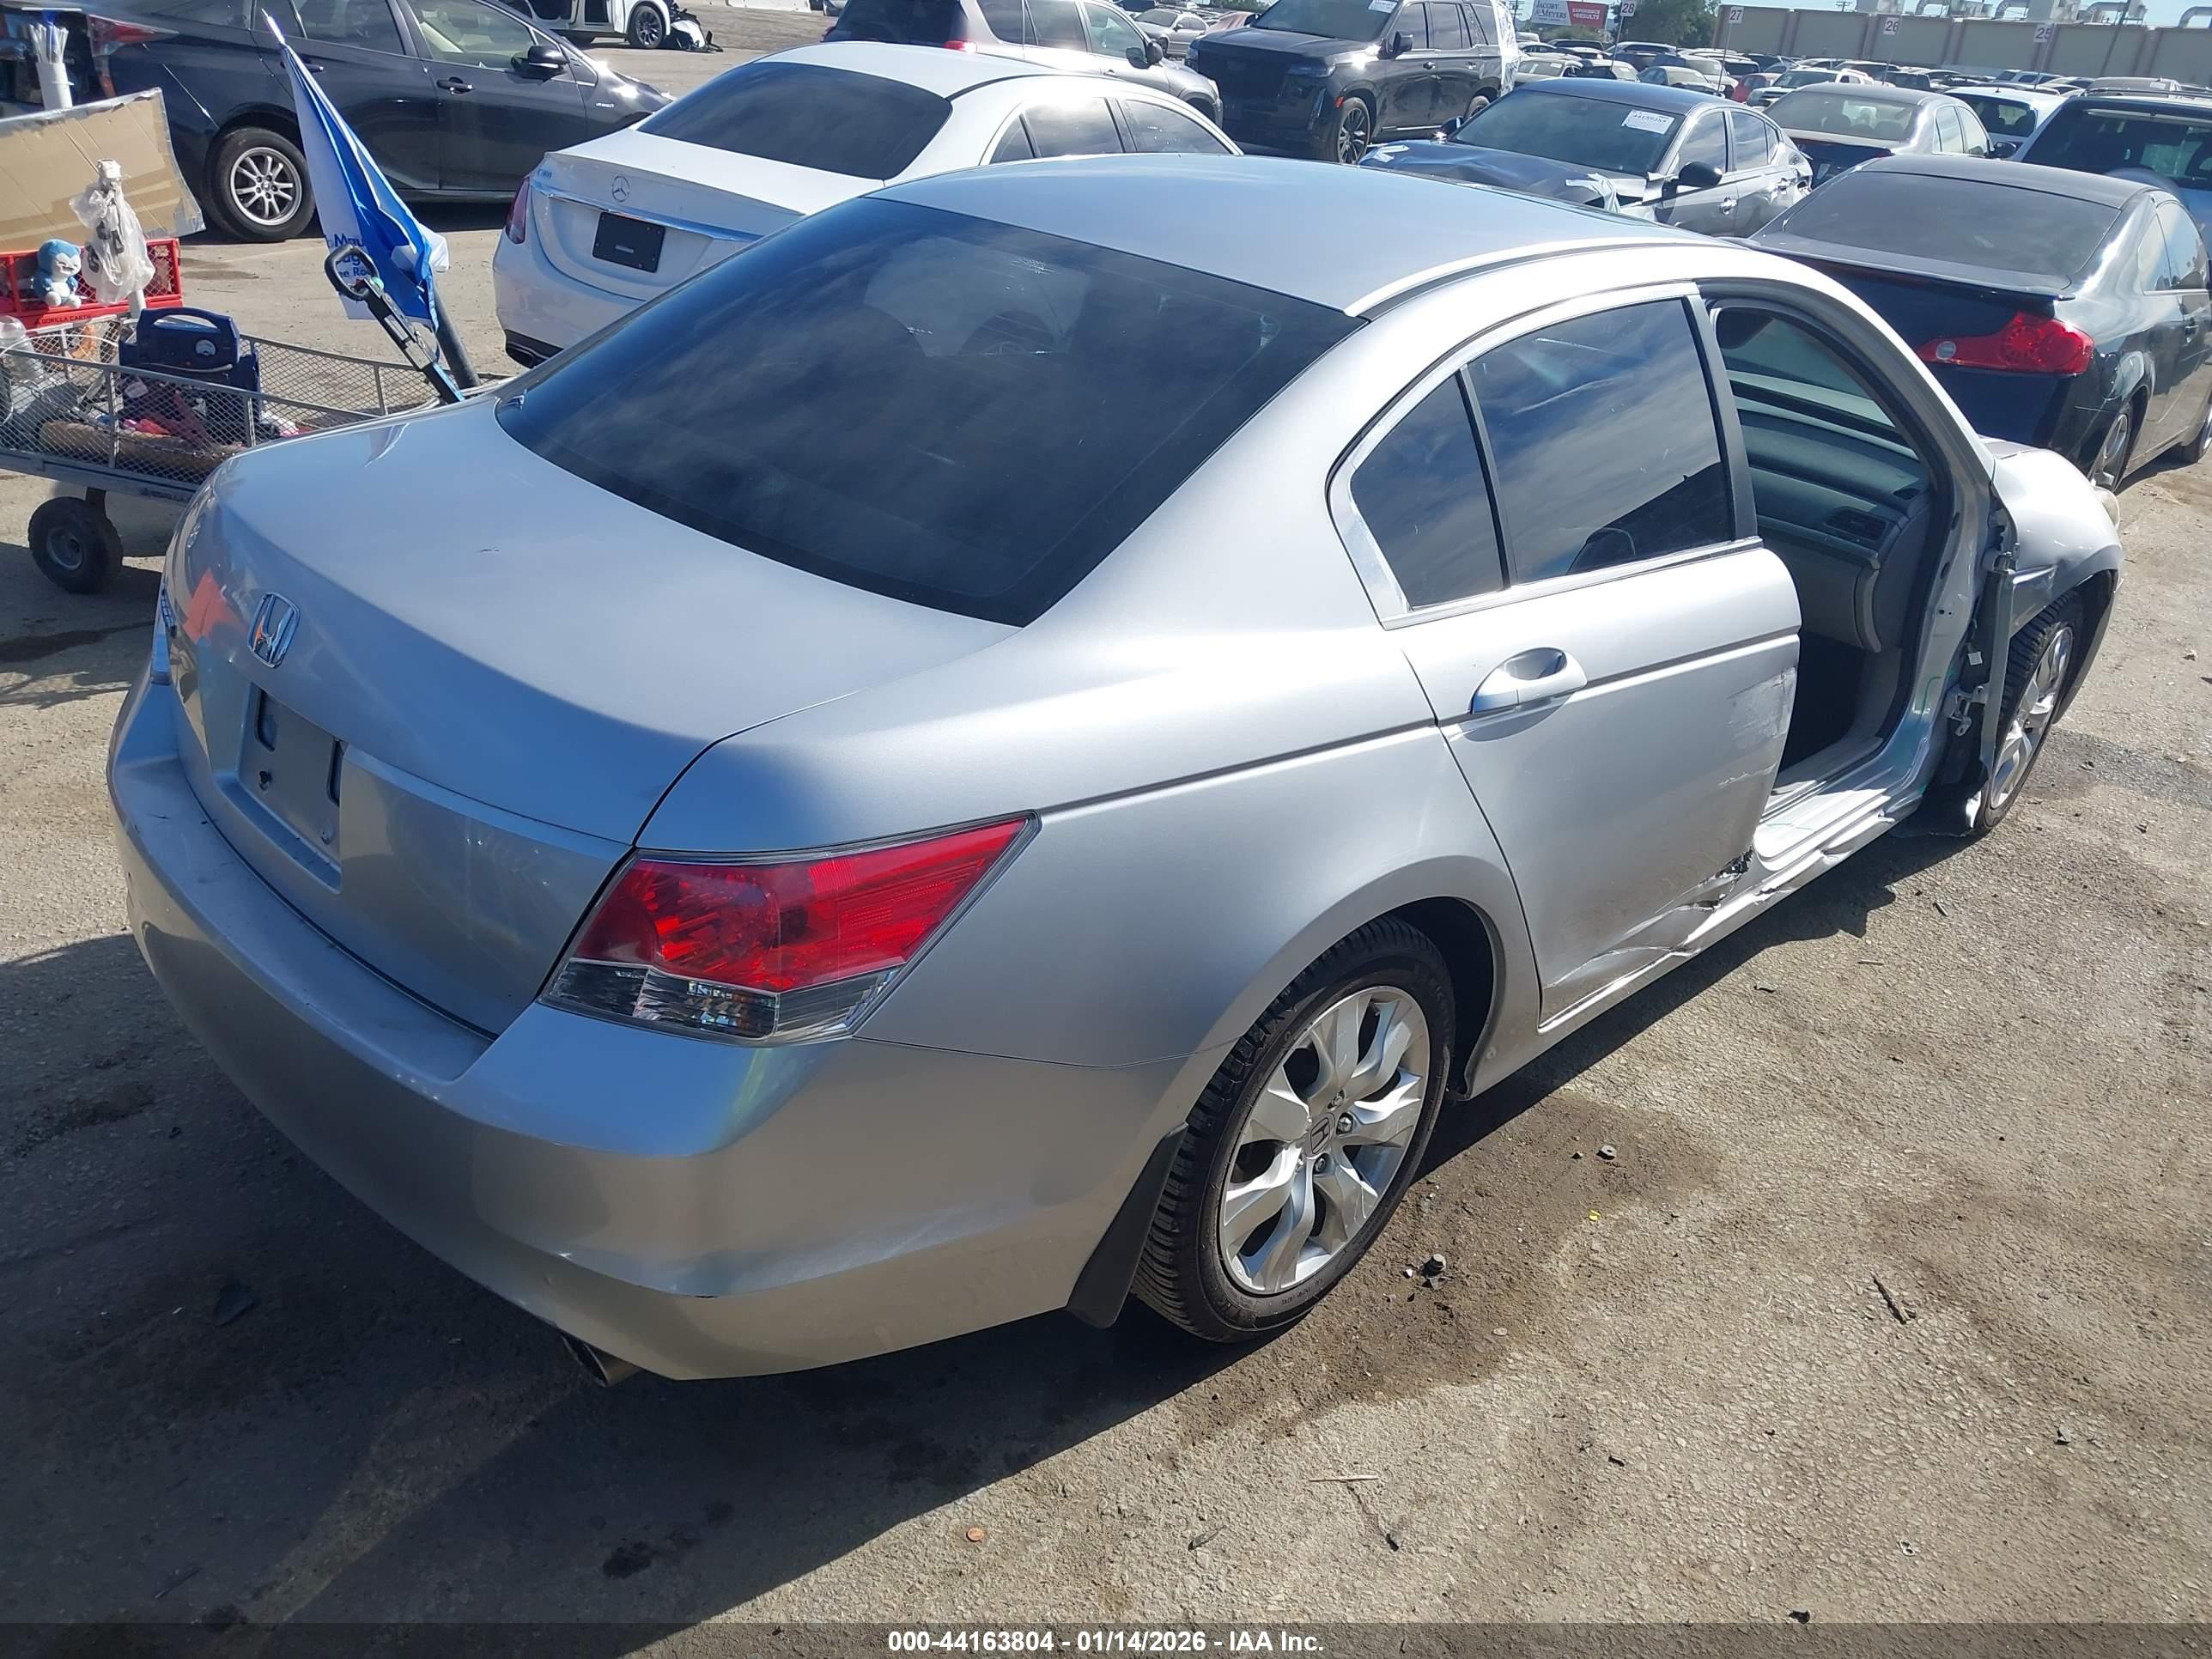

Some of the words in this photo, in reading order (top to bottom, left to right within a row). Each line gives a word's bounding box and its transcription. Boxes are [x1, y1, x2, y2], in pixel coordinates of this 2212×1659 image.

[1622, 3, 1635, 13] 28
[1541, 9, 1567, 19] MEYERS
[1730, 9, 1742, 21] 27
[1885, 21, 1898, 32] 26
